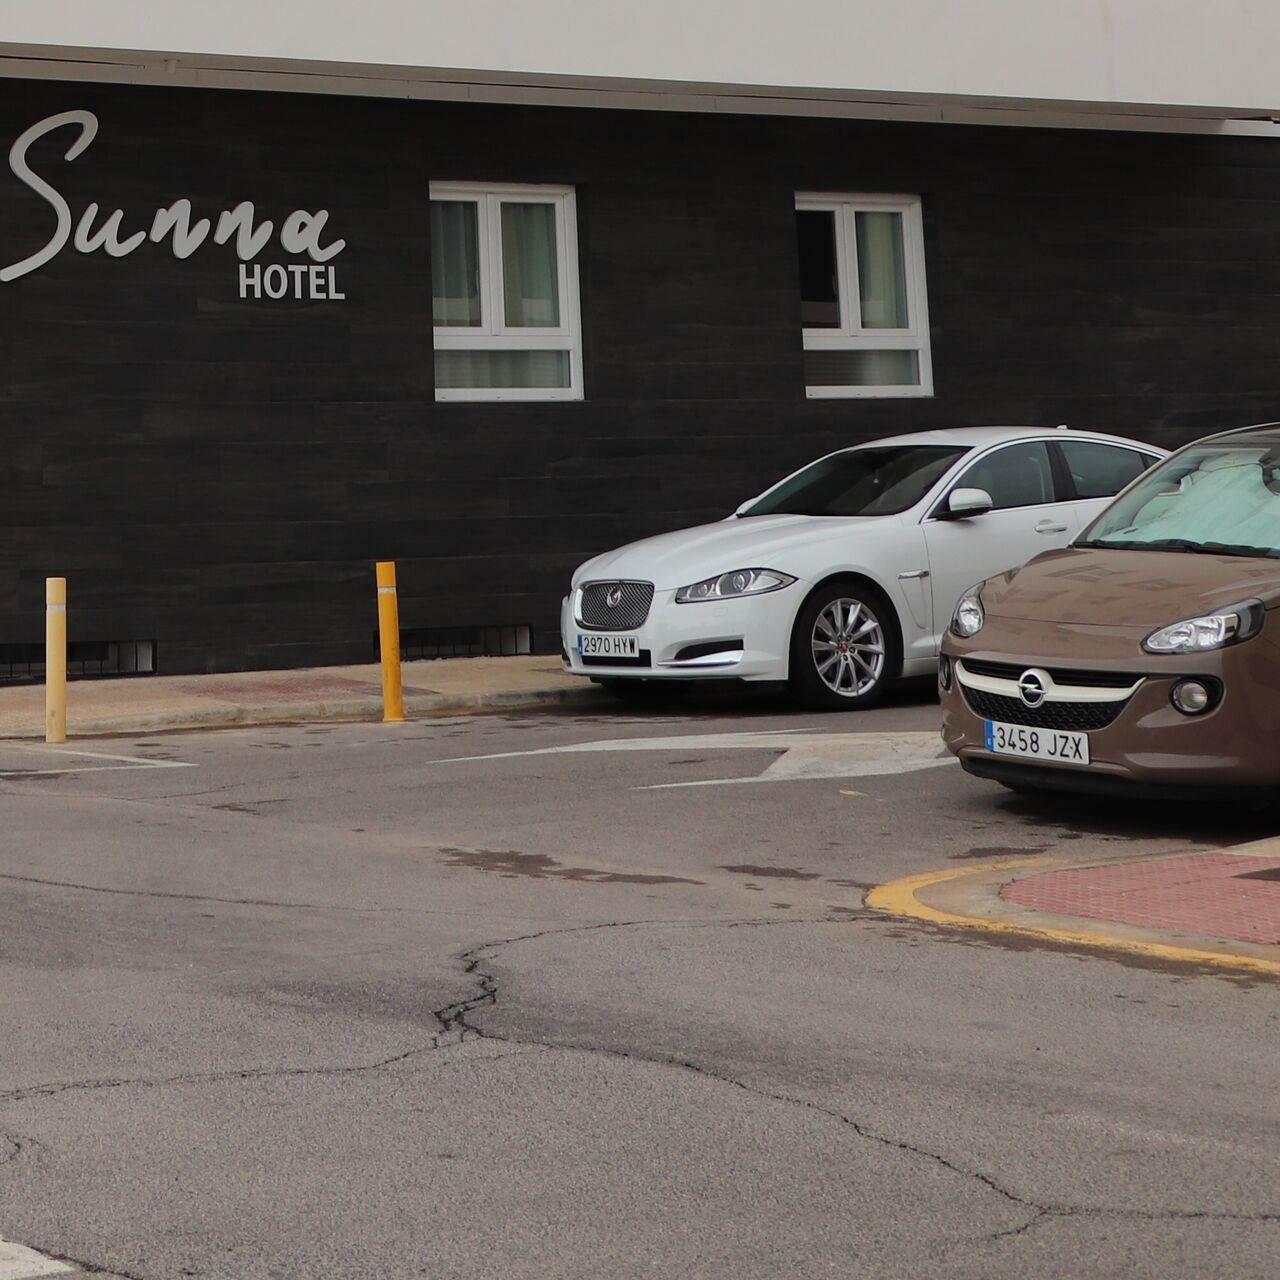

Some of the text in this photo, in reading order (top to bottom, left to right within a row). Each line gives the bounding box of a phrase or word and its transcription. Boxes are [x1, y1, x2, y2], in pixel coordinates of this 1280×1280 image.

[238, 263, 345, 300] HOTEL
[584, 637, 635, 654] 2970 HYW
[997, 727, 1082, 759] 3458 JZX
